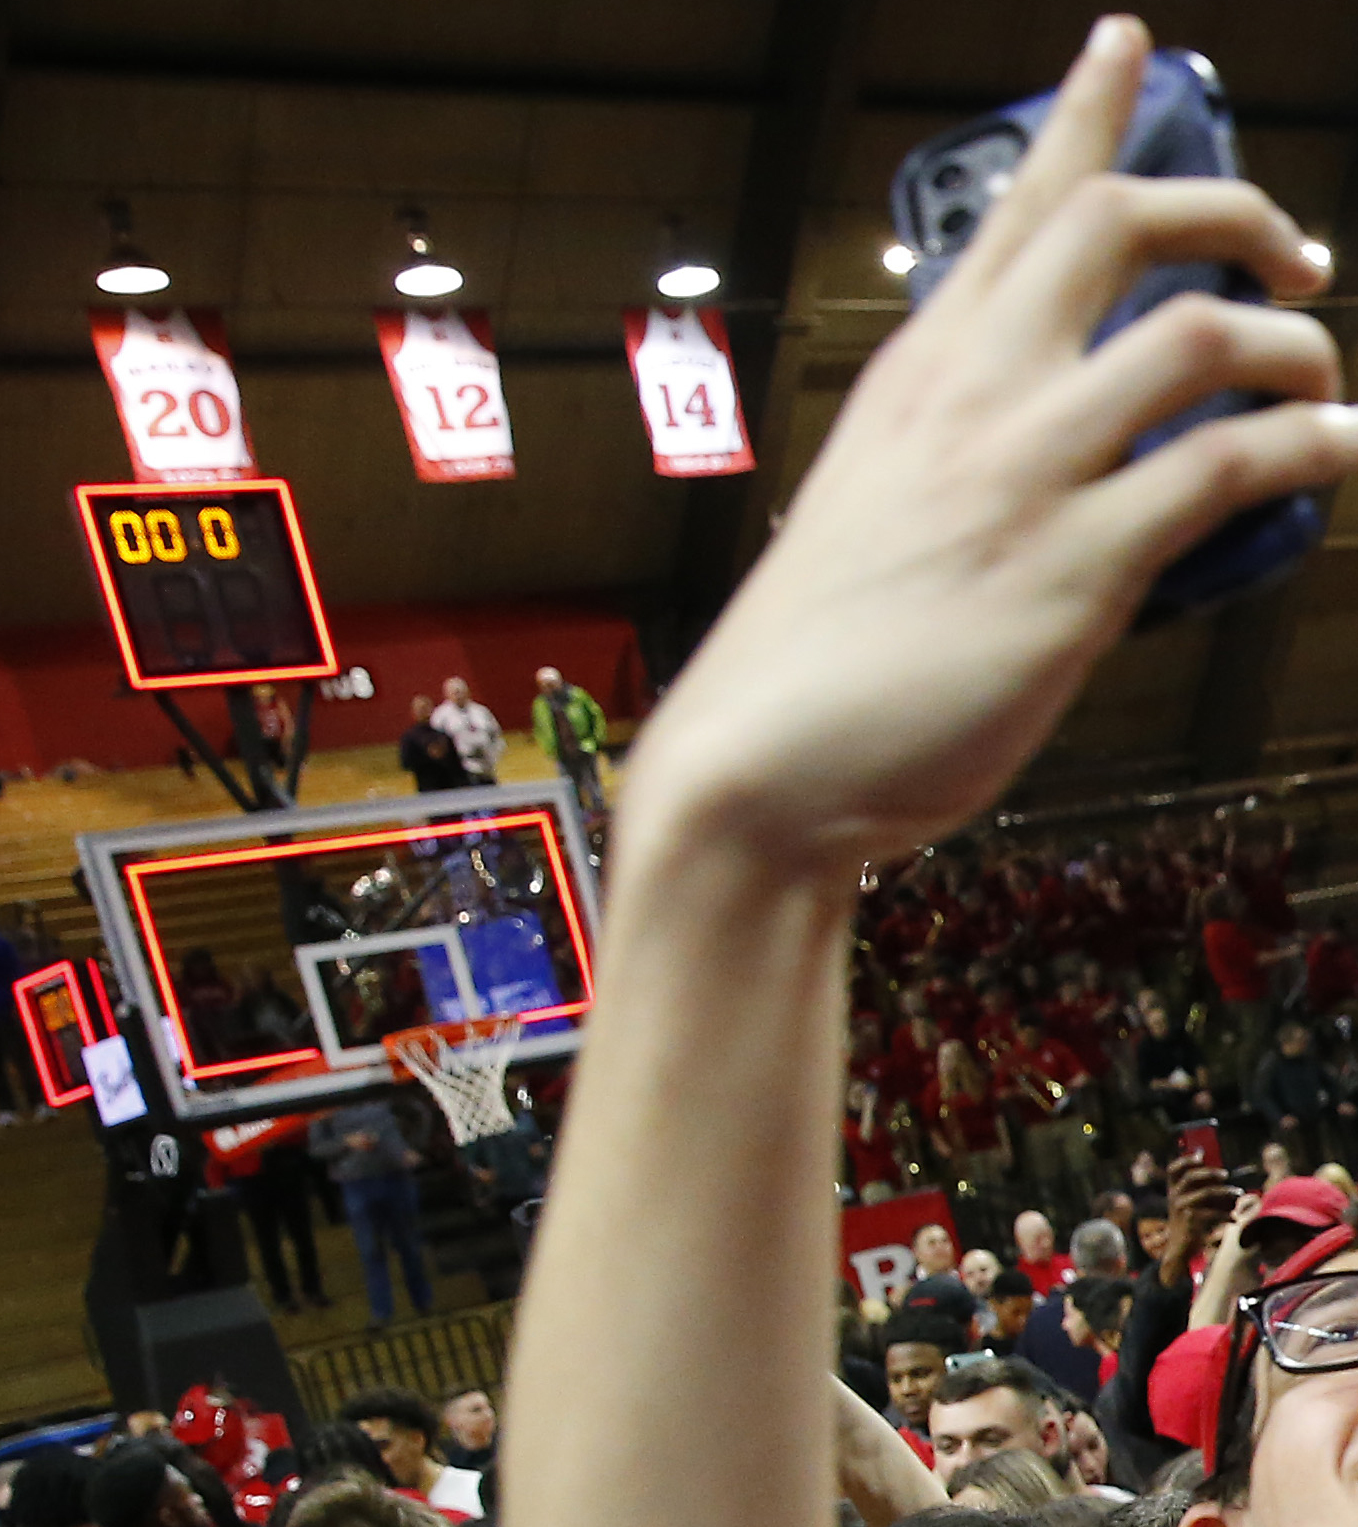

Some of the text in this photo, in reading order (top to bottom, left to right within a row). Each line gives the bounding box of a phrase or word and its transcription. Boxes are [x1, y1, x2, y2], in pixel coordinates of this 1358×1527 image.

[140, 388, 232, 439] 20
[425, 383, 500, 431] 12
[658, 382, 717, 428] 14
